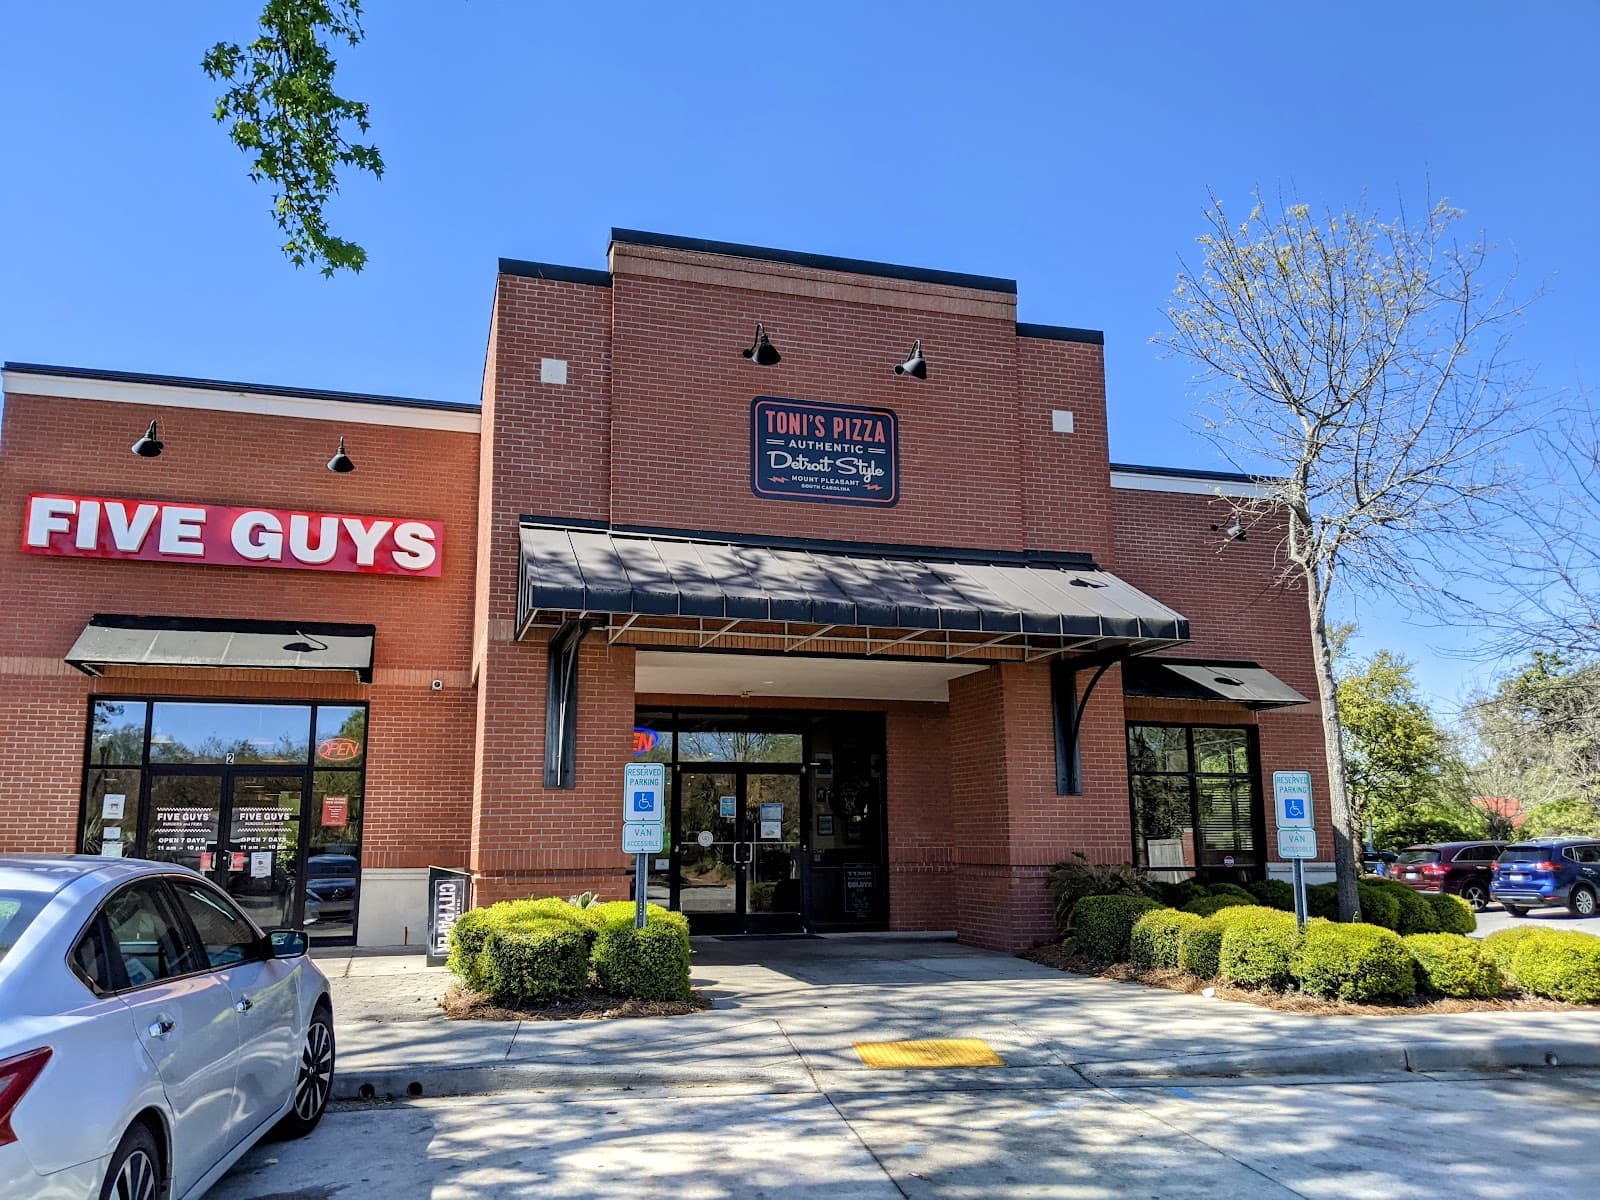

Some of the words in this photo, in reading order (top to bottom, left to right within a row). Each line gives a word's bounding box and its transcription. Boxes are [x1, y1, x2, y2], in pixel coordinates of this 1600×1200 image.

[765, 410, 825, 438] TONI'S
[833, 416, 886, 443] PIZZA
[788, 439, 864, 454] AUTHENTIC
[766, 450, 834, 472] Detroit
[835, 457, 885, 483] Style
[791, 475, 819, 483] MOUNT
[820, 477, 861, 486] PLEASANT
[27, 497, 207, 556] FIVE
[230, 511, 437, 570] GUYS
[633, 732, 654, 752] EN
[318, 742, 360, 757] OPEN
[226, 753, 234, 764] 2
[627, 768, 662, 777] RESERVED
[629, 778, 660, 786] PARKING
[1276, 776, 1309, 785] RESERVED
[1279, 786, 1307, 794] PARKING
[157, 812, 181, 821] FIVE
[182, 812, 209, 821] GUYS
[240, 812, 262, 821] FIVE
[263, 812, 290, 821] GUYS
[634, 828, 652, 837] VAN
[1288, 834, 1306, 843] VAN
[438, 883, 457, 911] CITY
[436, 912, 456, 953] PAPER
